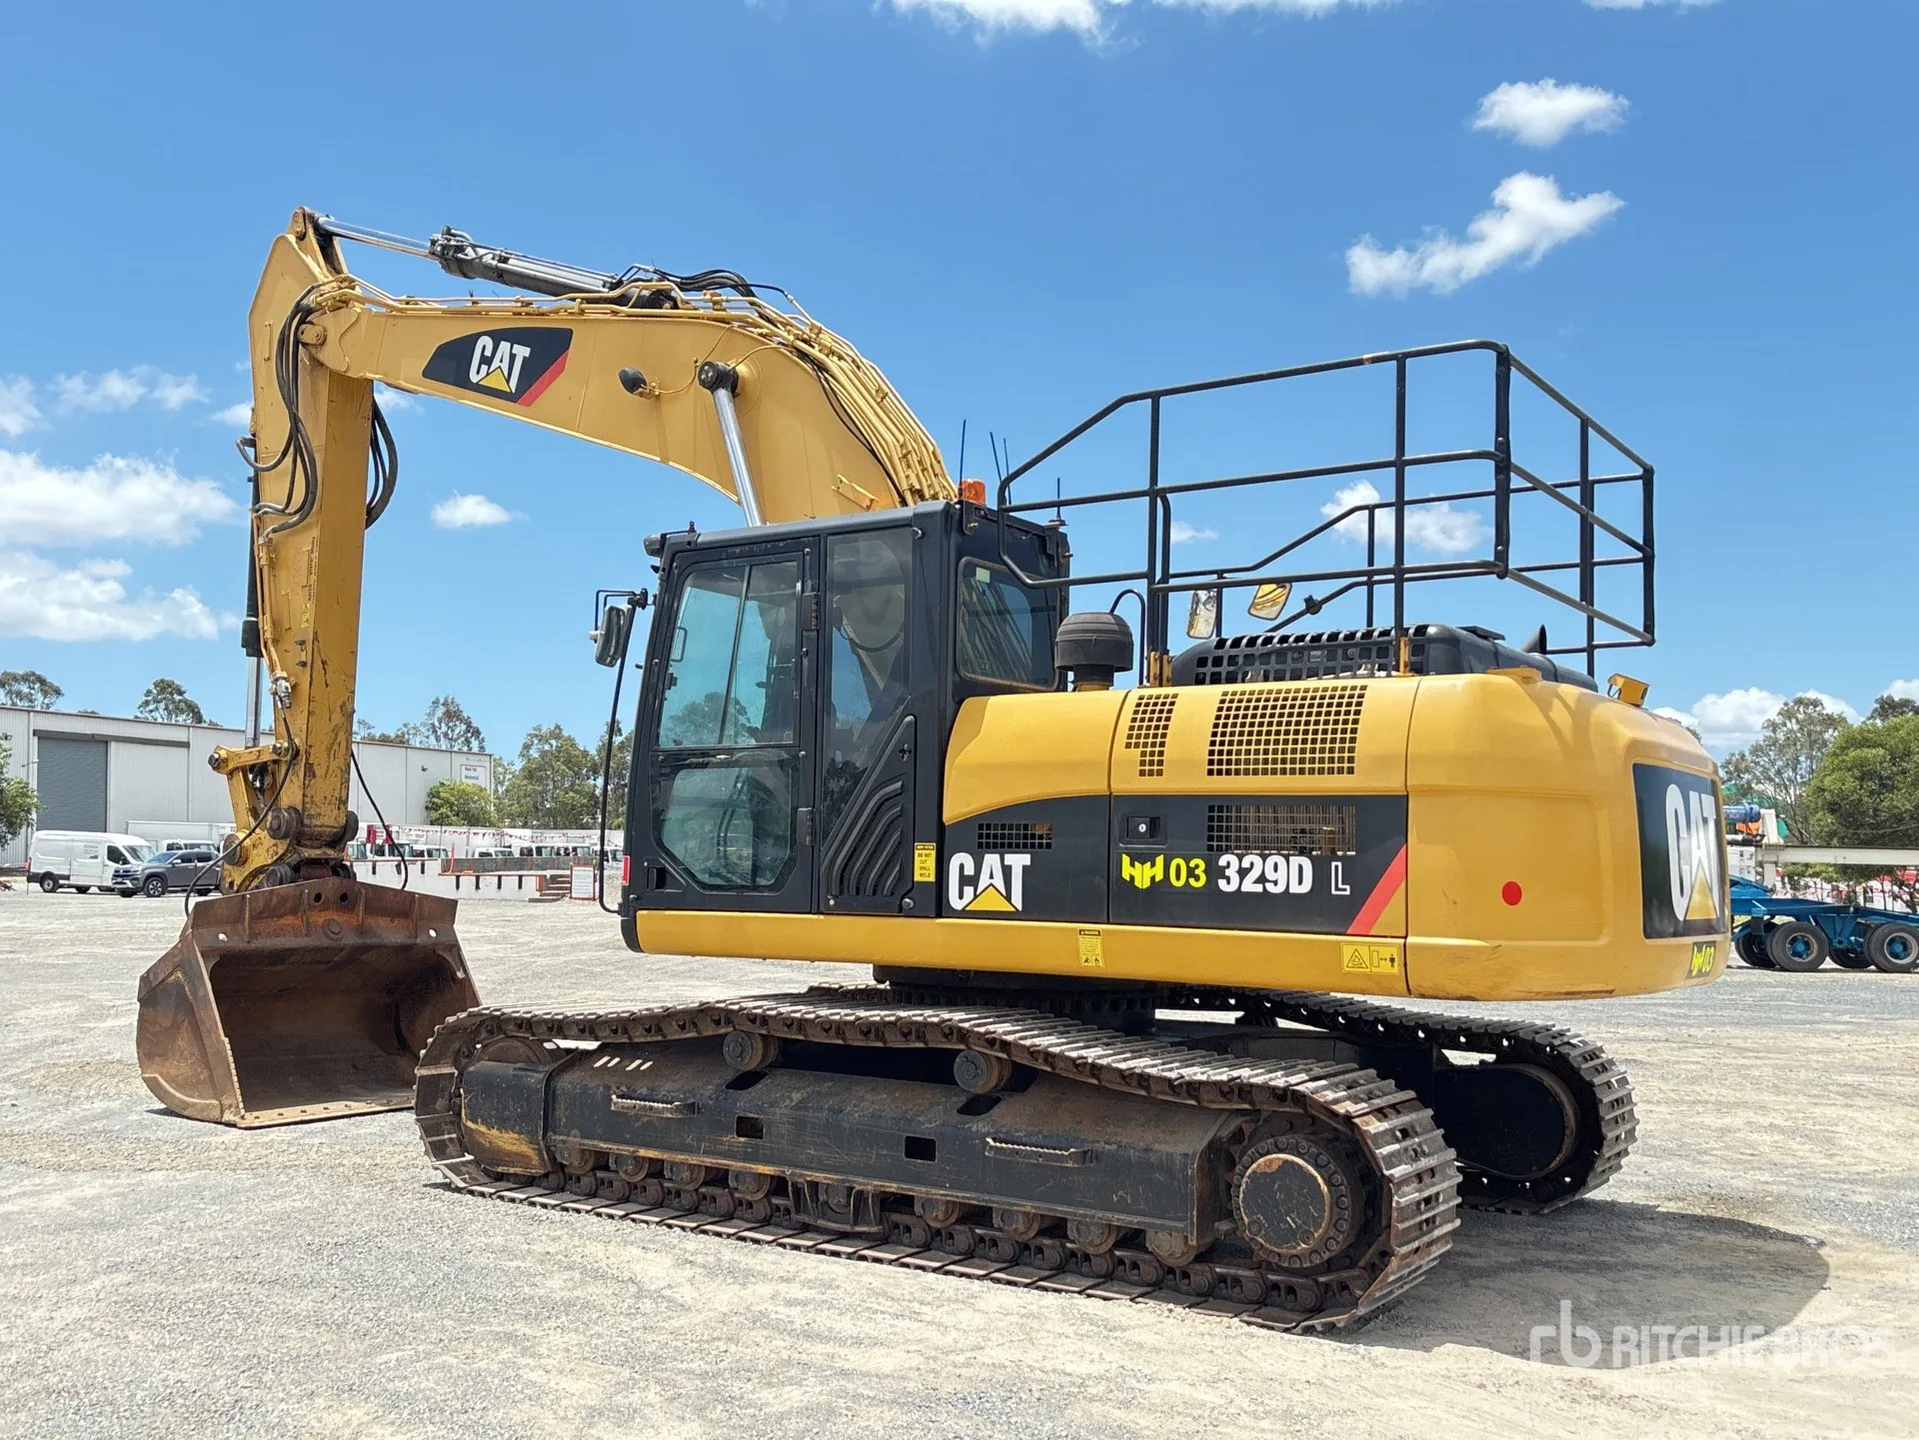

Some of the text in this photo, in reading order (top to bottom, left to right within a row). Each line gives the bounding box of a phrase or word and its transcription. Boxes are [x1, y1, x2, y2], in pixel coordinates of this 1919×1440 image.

[469, 335, 531, 394] CAT
[948, 852, 1031, 912] CAT
[1168, 858, 1207, 888] 03
[1217, 854, 1313, 894] 329D
[1331, 862, 1351, 896] L
[1666, 783, 1720, 922] CAT
